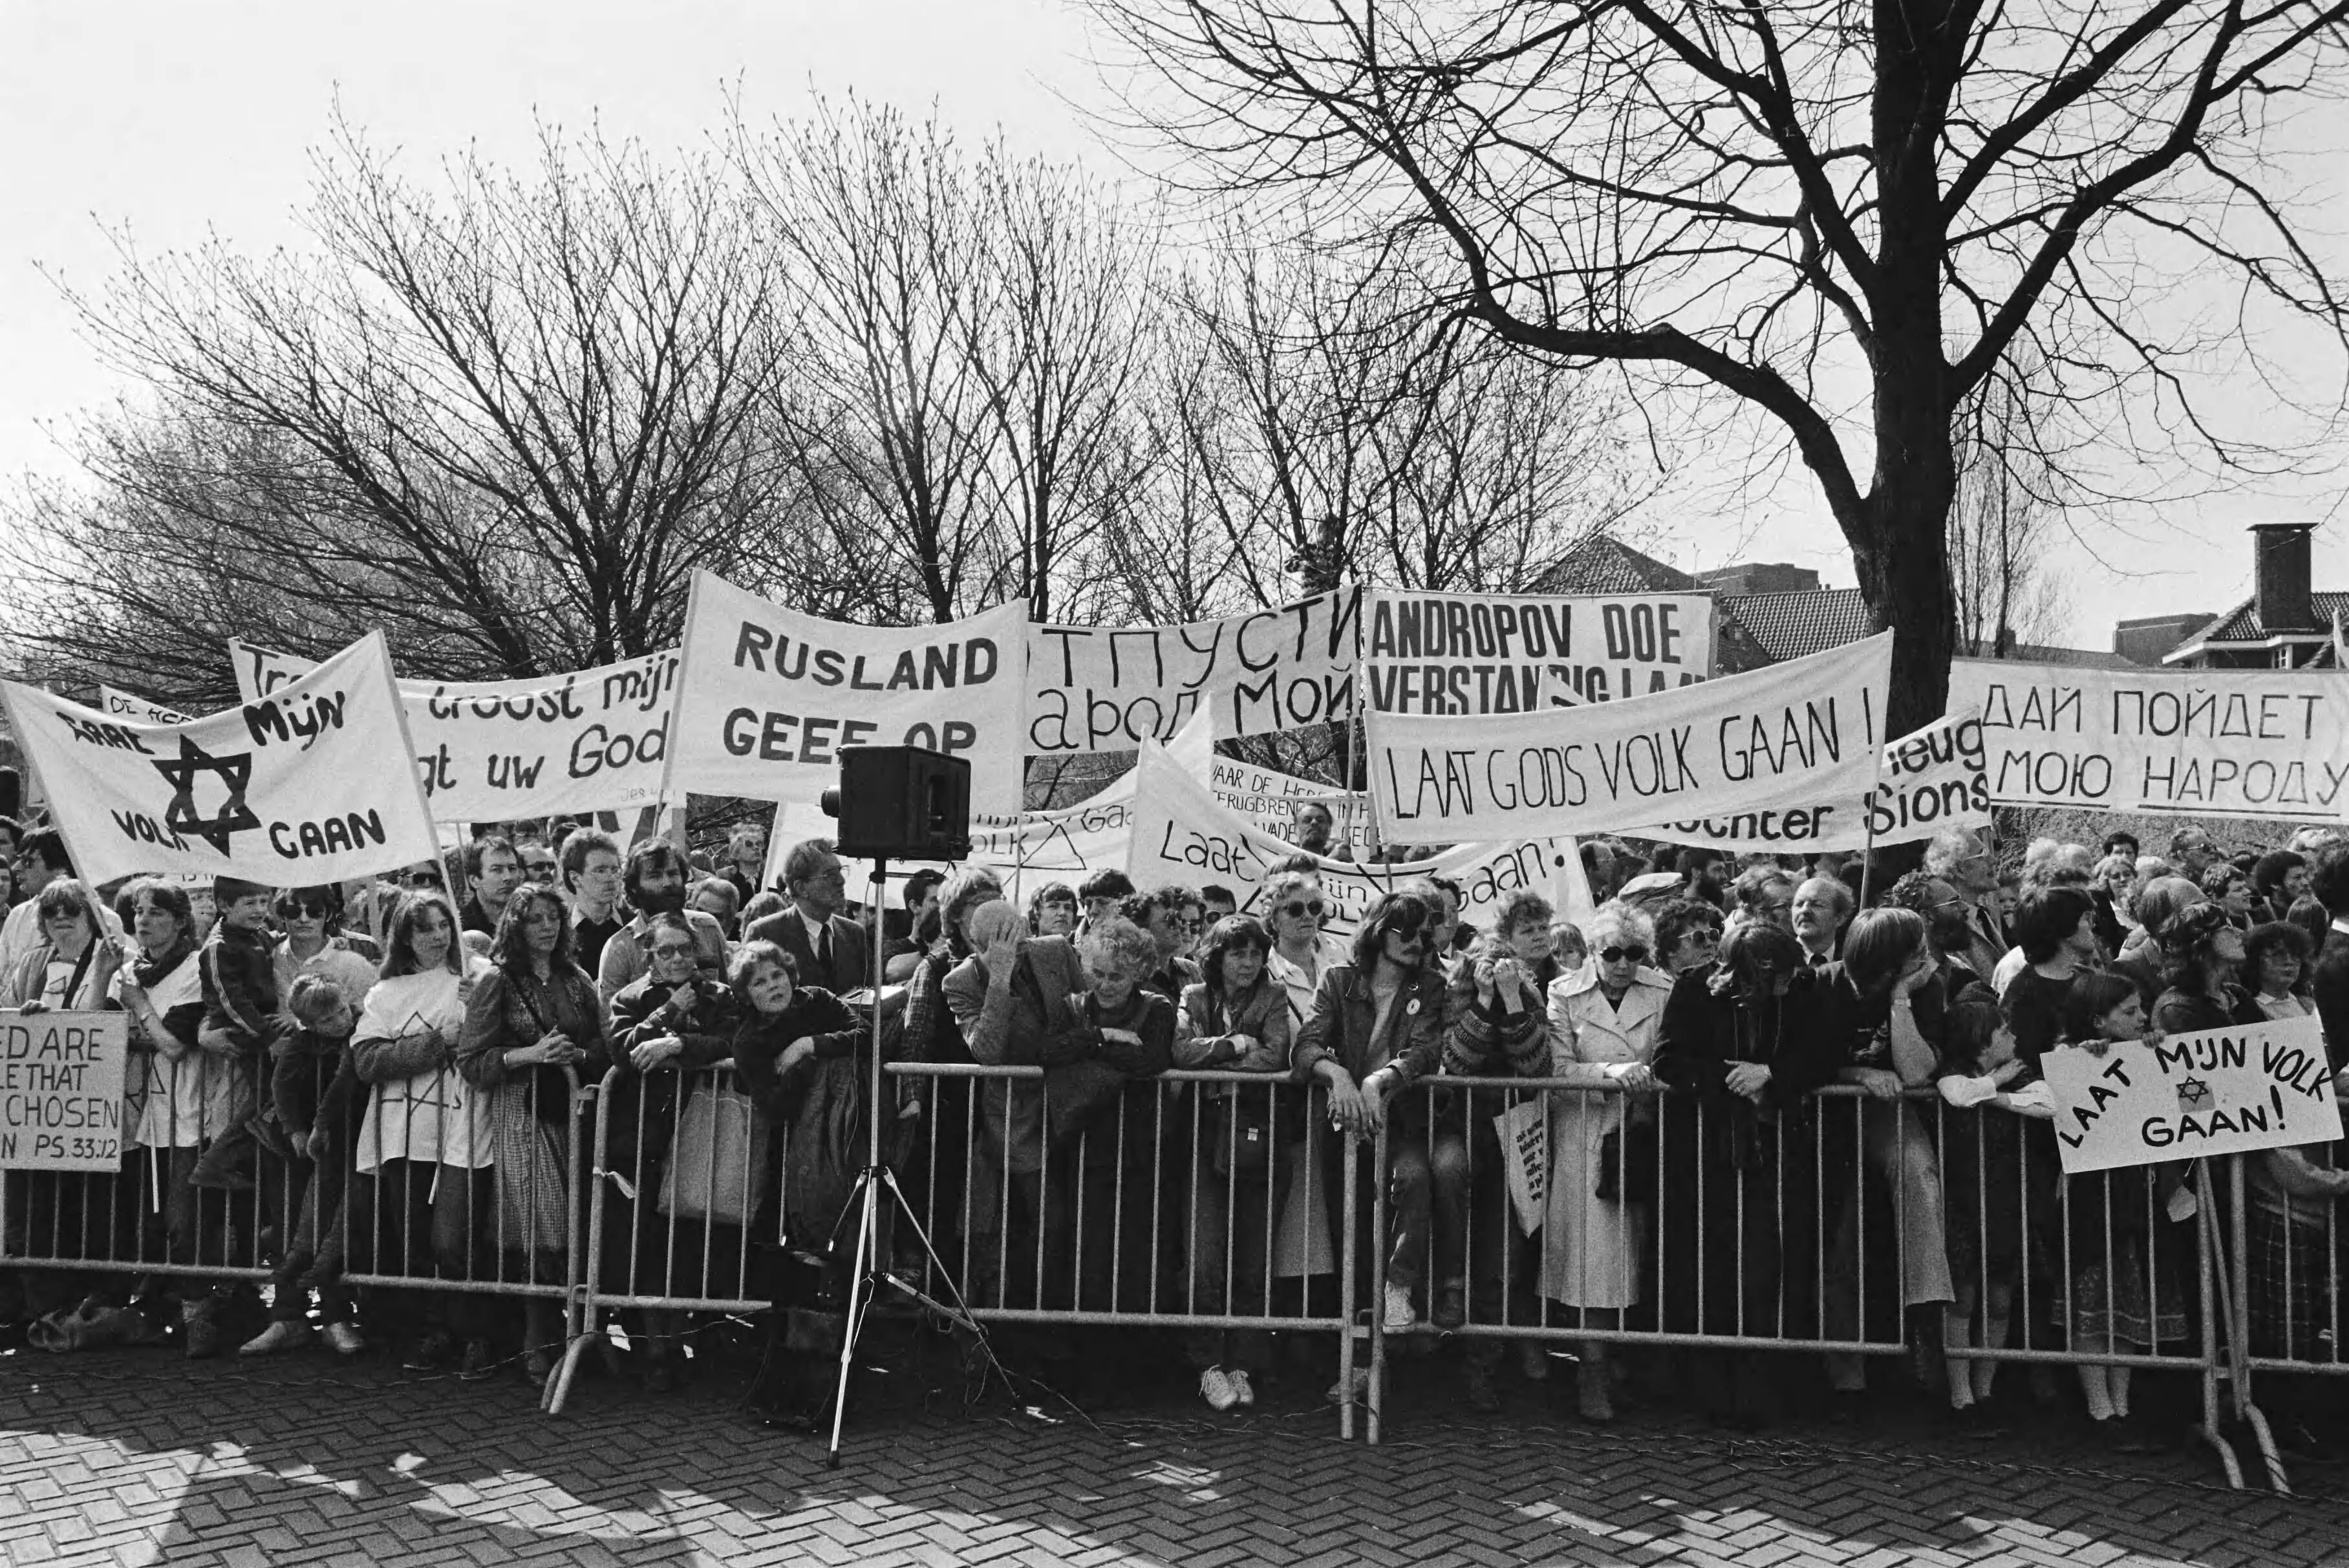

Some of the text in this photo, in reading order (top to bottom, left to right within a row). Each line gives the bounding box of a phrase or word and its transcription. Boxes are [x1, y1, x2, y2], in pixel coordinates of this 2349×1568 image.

[734, 621, 998, 691] RUSLAND
[1026, 582, 1362, 688] ТПУСТИ
[1371, 600, 1681, 664] ANDROPOV DOE
[111, 696, 137, 714] DE
[1982, 684, 2324, 740] ДАЙ ПОЙДЕТ
[487, 754, 544, 789] uw
[568, 711, 670, 779] God
[724, 708, 976, 764] GEEF OP
[1387, 747, 1475, 819] LAAT
[1594, 725, 1699, 800] VOLK
[1719, 697, 1840, 782] GAAN
[1887, 717, 1986, 773] eug
[1212, 789, 1303, 816] ERUGBREN
[1213, 765, 1244, 788] AAR
[1252, 774, 1272, 794] DE
[1863, 772, 1990, 835] Sions
[1997, 750, 2349, 806] МОЮ НАРОДУ
[269, 808, 386, 859] GAAN
[1160, 820, 1255, 882] Laat
[38, 1027, 103, 1061] ARE
[26, 1063, 89, 1091] THAT
[2059, 1058, 2130, 1148] LAAT
[2263, 1041, 2332, 1102] VOLK
[6, 1095, 119, 1129] CHOSEN
